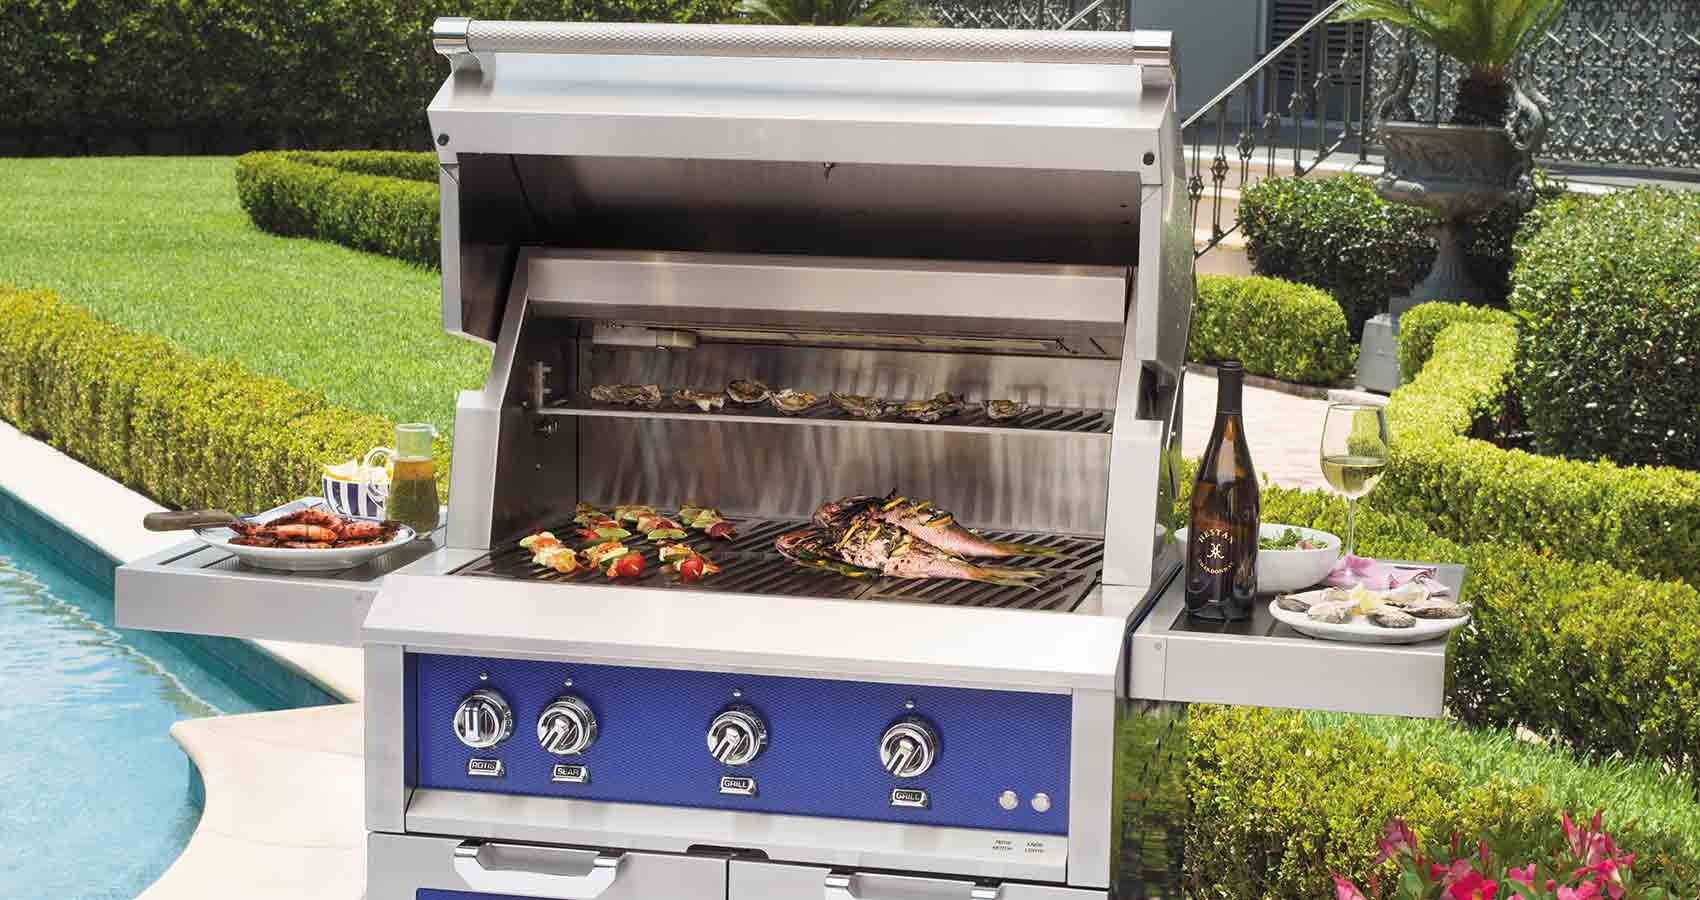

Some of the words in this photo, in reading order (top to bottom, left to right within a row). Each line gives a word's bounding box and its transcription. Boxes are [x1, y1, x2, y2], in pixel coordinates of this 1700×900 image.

[557, 767, 580, 776] SEAR
[724, 780, 748, 789] GRILL
[896, 791, 920, 801] GRILL
